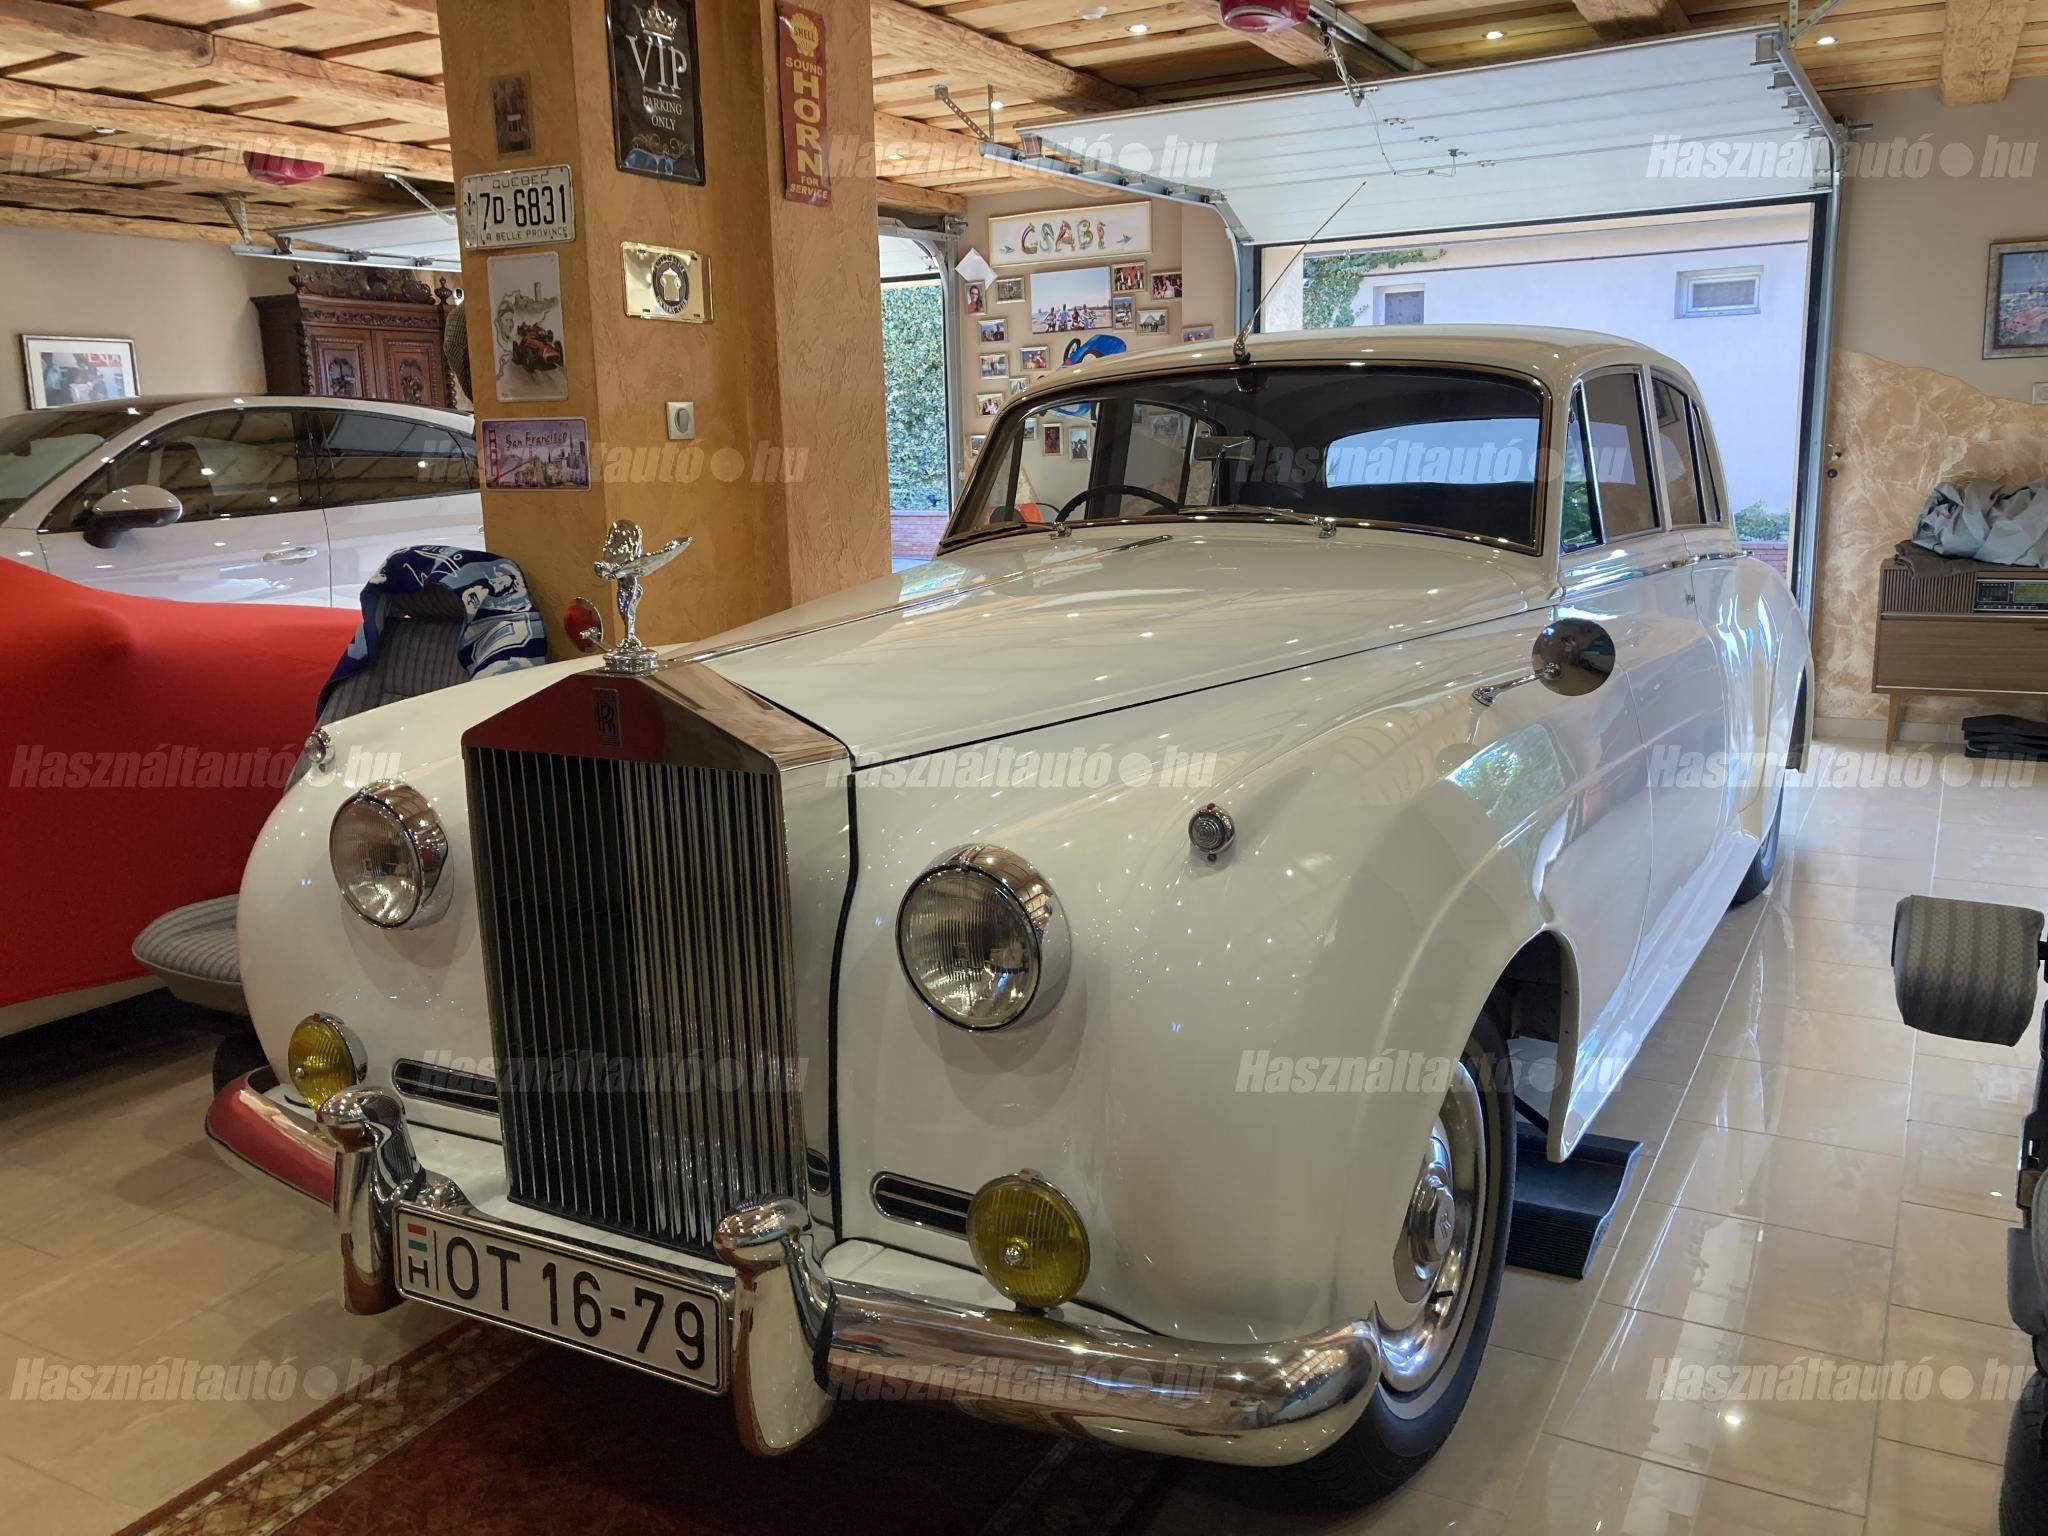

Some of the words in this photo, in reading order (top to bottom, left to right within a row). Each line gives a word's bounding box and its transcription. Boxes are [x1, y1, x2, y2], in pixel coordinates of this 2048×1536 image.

[794, 26, 815, 41] SHELL
[625, 34, 687, 90] VIP
[785, 56, 823, 76] SOUND
[642, 95, 682, 116] PARKING
[651, 115, 676, 131] ONLY
[793, 70, 823, 177] HORN
[492, 171, 550, 190] QUEBEC
[800, 176, 819, 187] FOR
[790, 184, 829, 199] SERVICE
[480, 231, 492, 241] LA
[496, 230, 522, 241] BELLE
[526, 226, 569, 238] PROVINCE
[505, 433, 523, 449] San
[408, 1256, 429, 1289] H
[542, 1262, 705, 1370] 16-79
